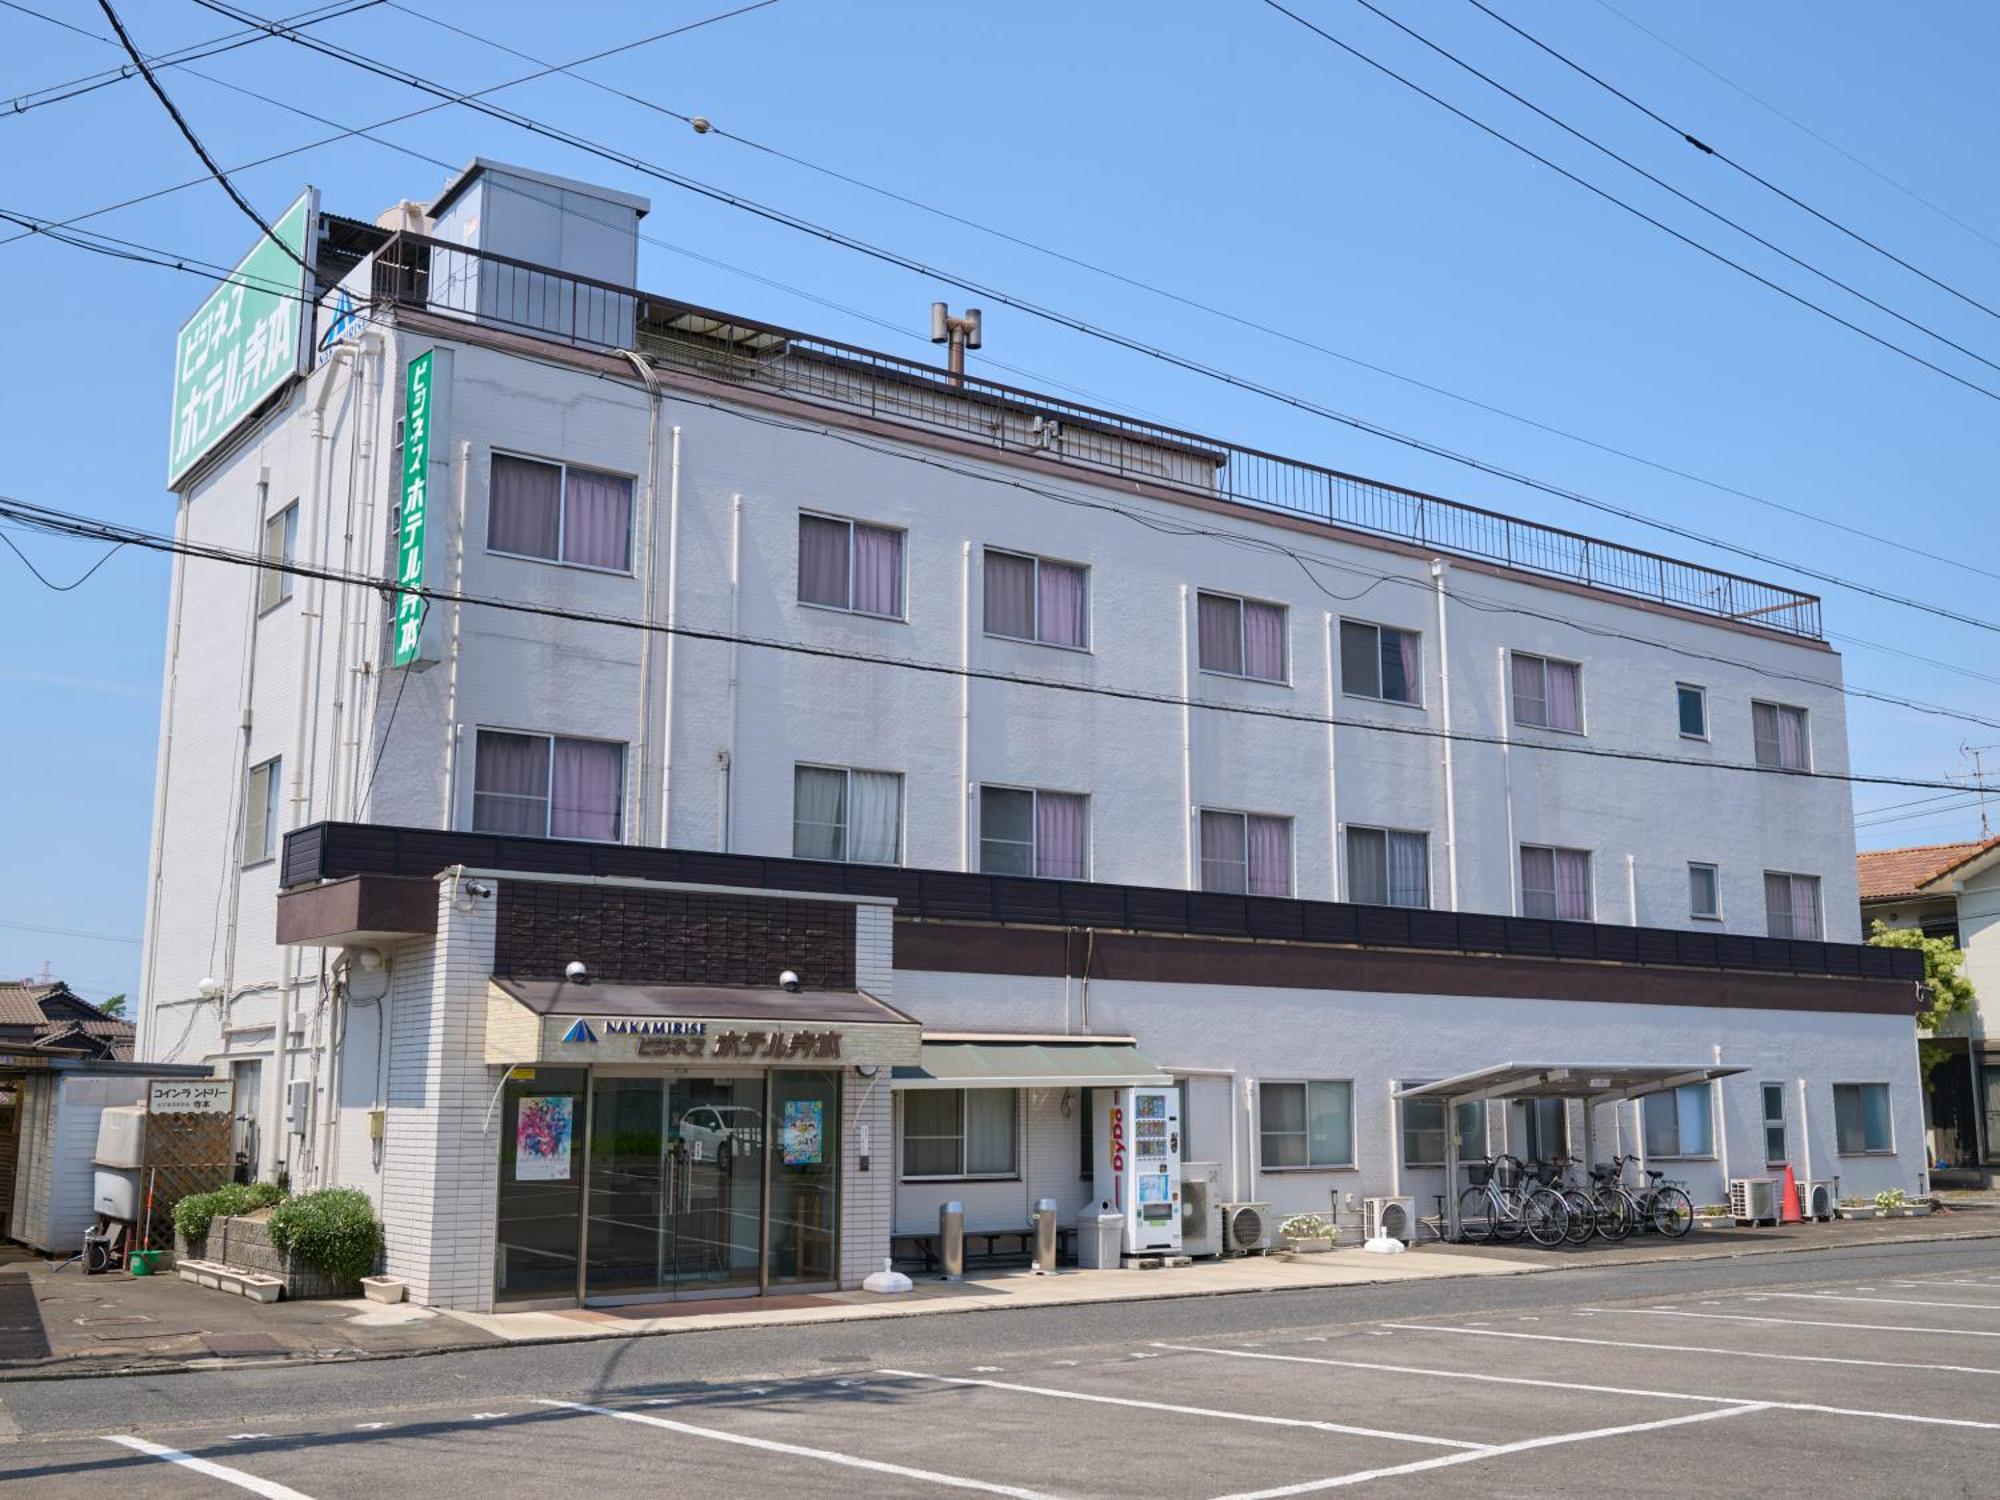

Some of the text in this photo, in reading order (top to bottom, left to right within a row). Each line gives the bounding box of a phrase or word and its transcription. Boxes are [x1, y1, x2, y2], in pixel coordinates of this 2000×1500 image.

[183, 277, 246, 383] ビジネス
[175, 292, 295, 464] ホテル寺本
[604, 1021, 707, 1035] NAKAMIRISE
[1113, 1108, 1126, 1171] DyDo
